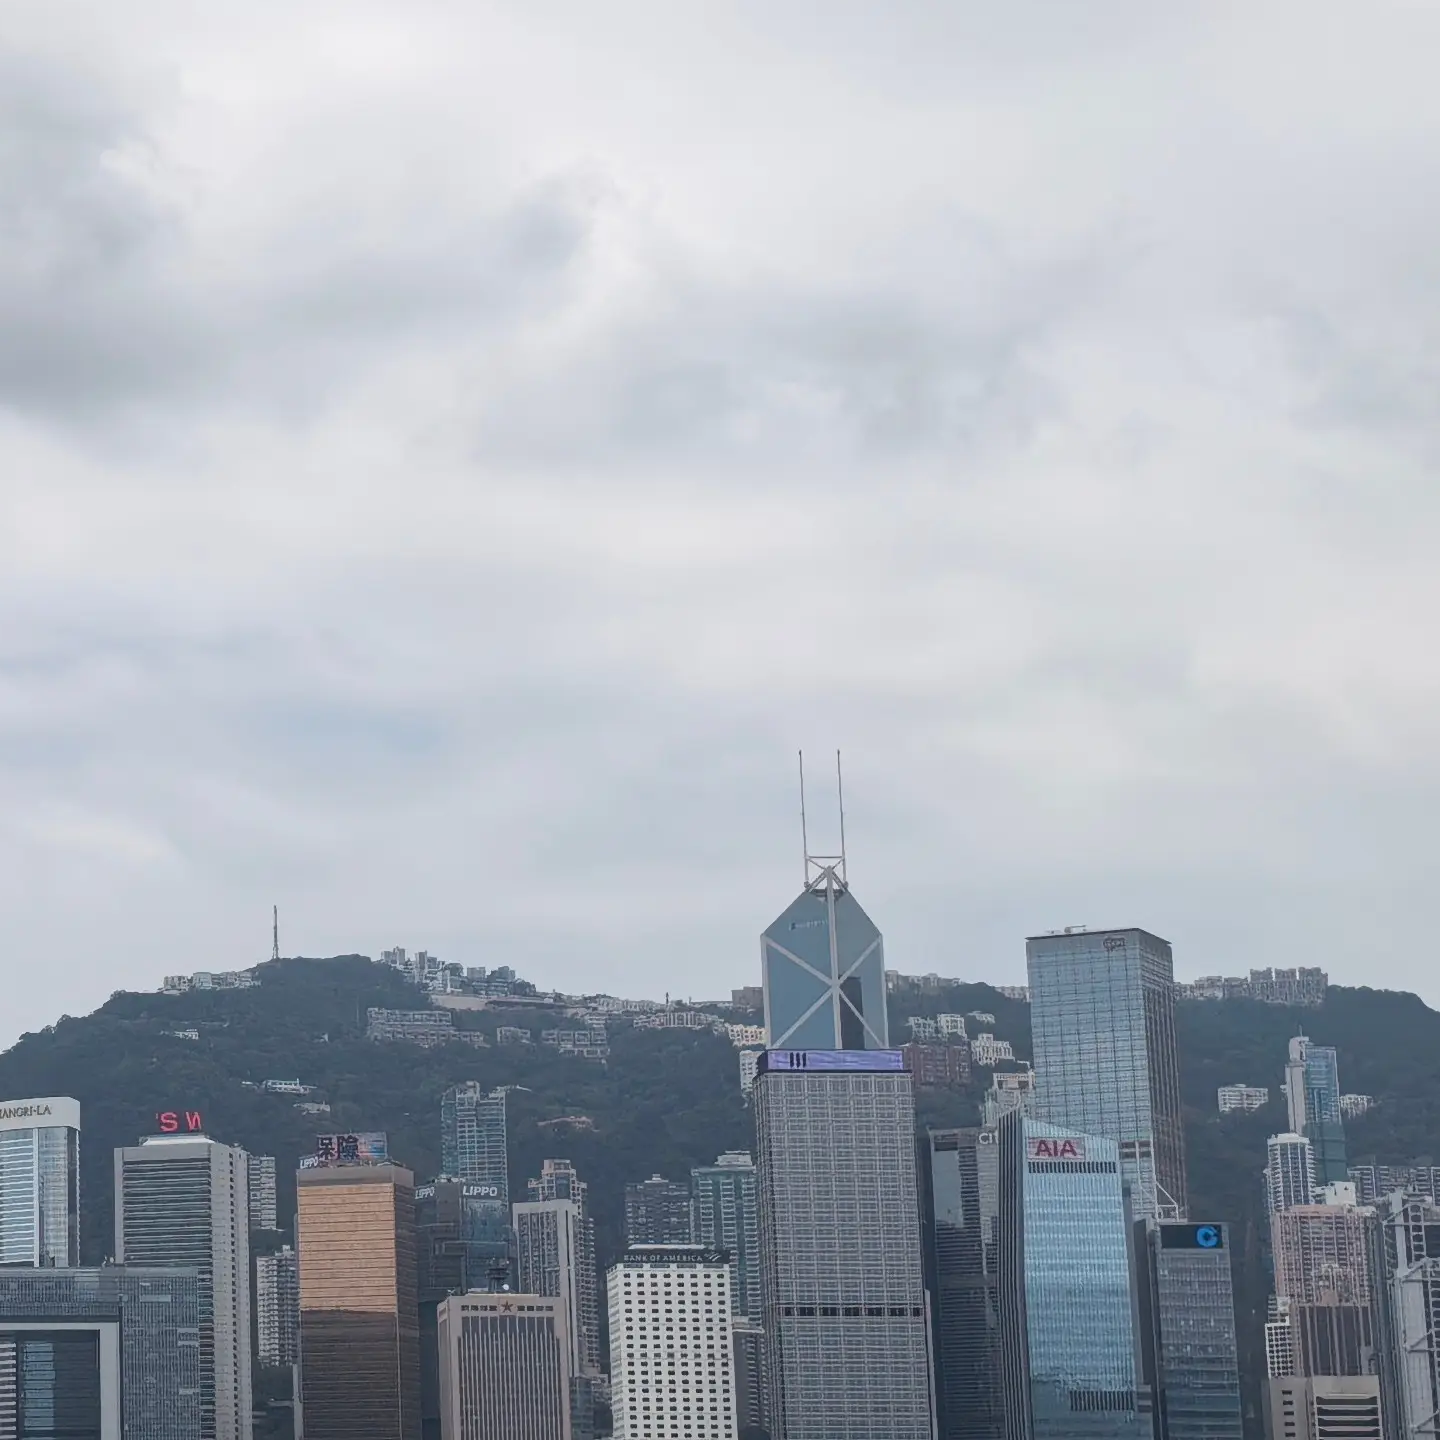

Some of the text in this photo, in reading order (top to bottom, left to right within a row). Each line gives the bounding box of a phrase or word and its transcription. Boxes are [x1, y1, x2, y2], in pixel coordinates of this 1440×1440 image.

[1035, 1139, 1077, 1157] AIA
[415, 1186, 435, 1200] LIPPO
[462, 1185, 498, 1197] LIPPO
[623, 1254, 703, 1262] BANK OF AMERICA
